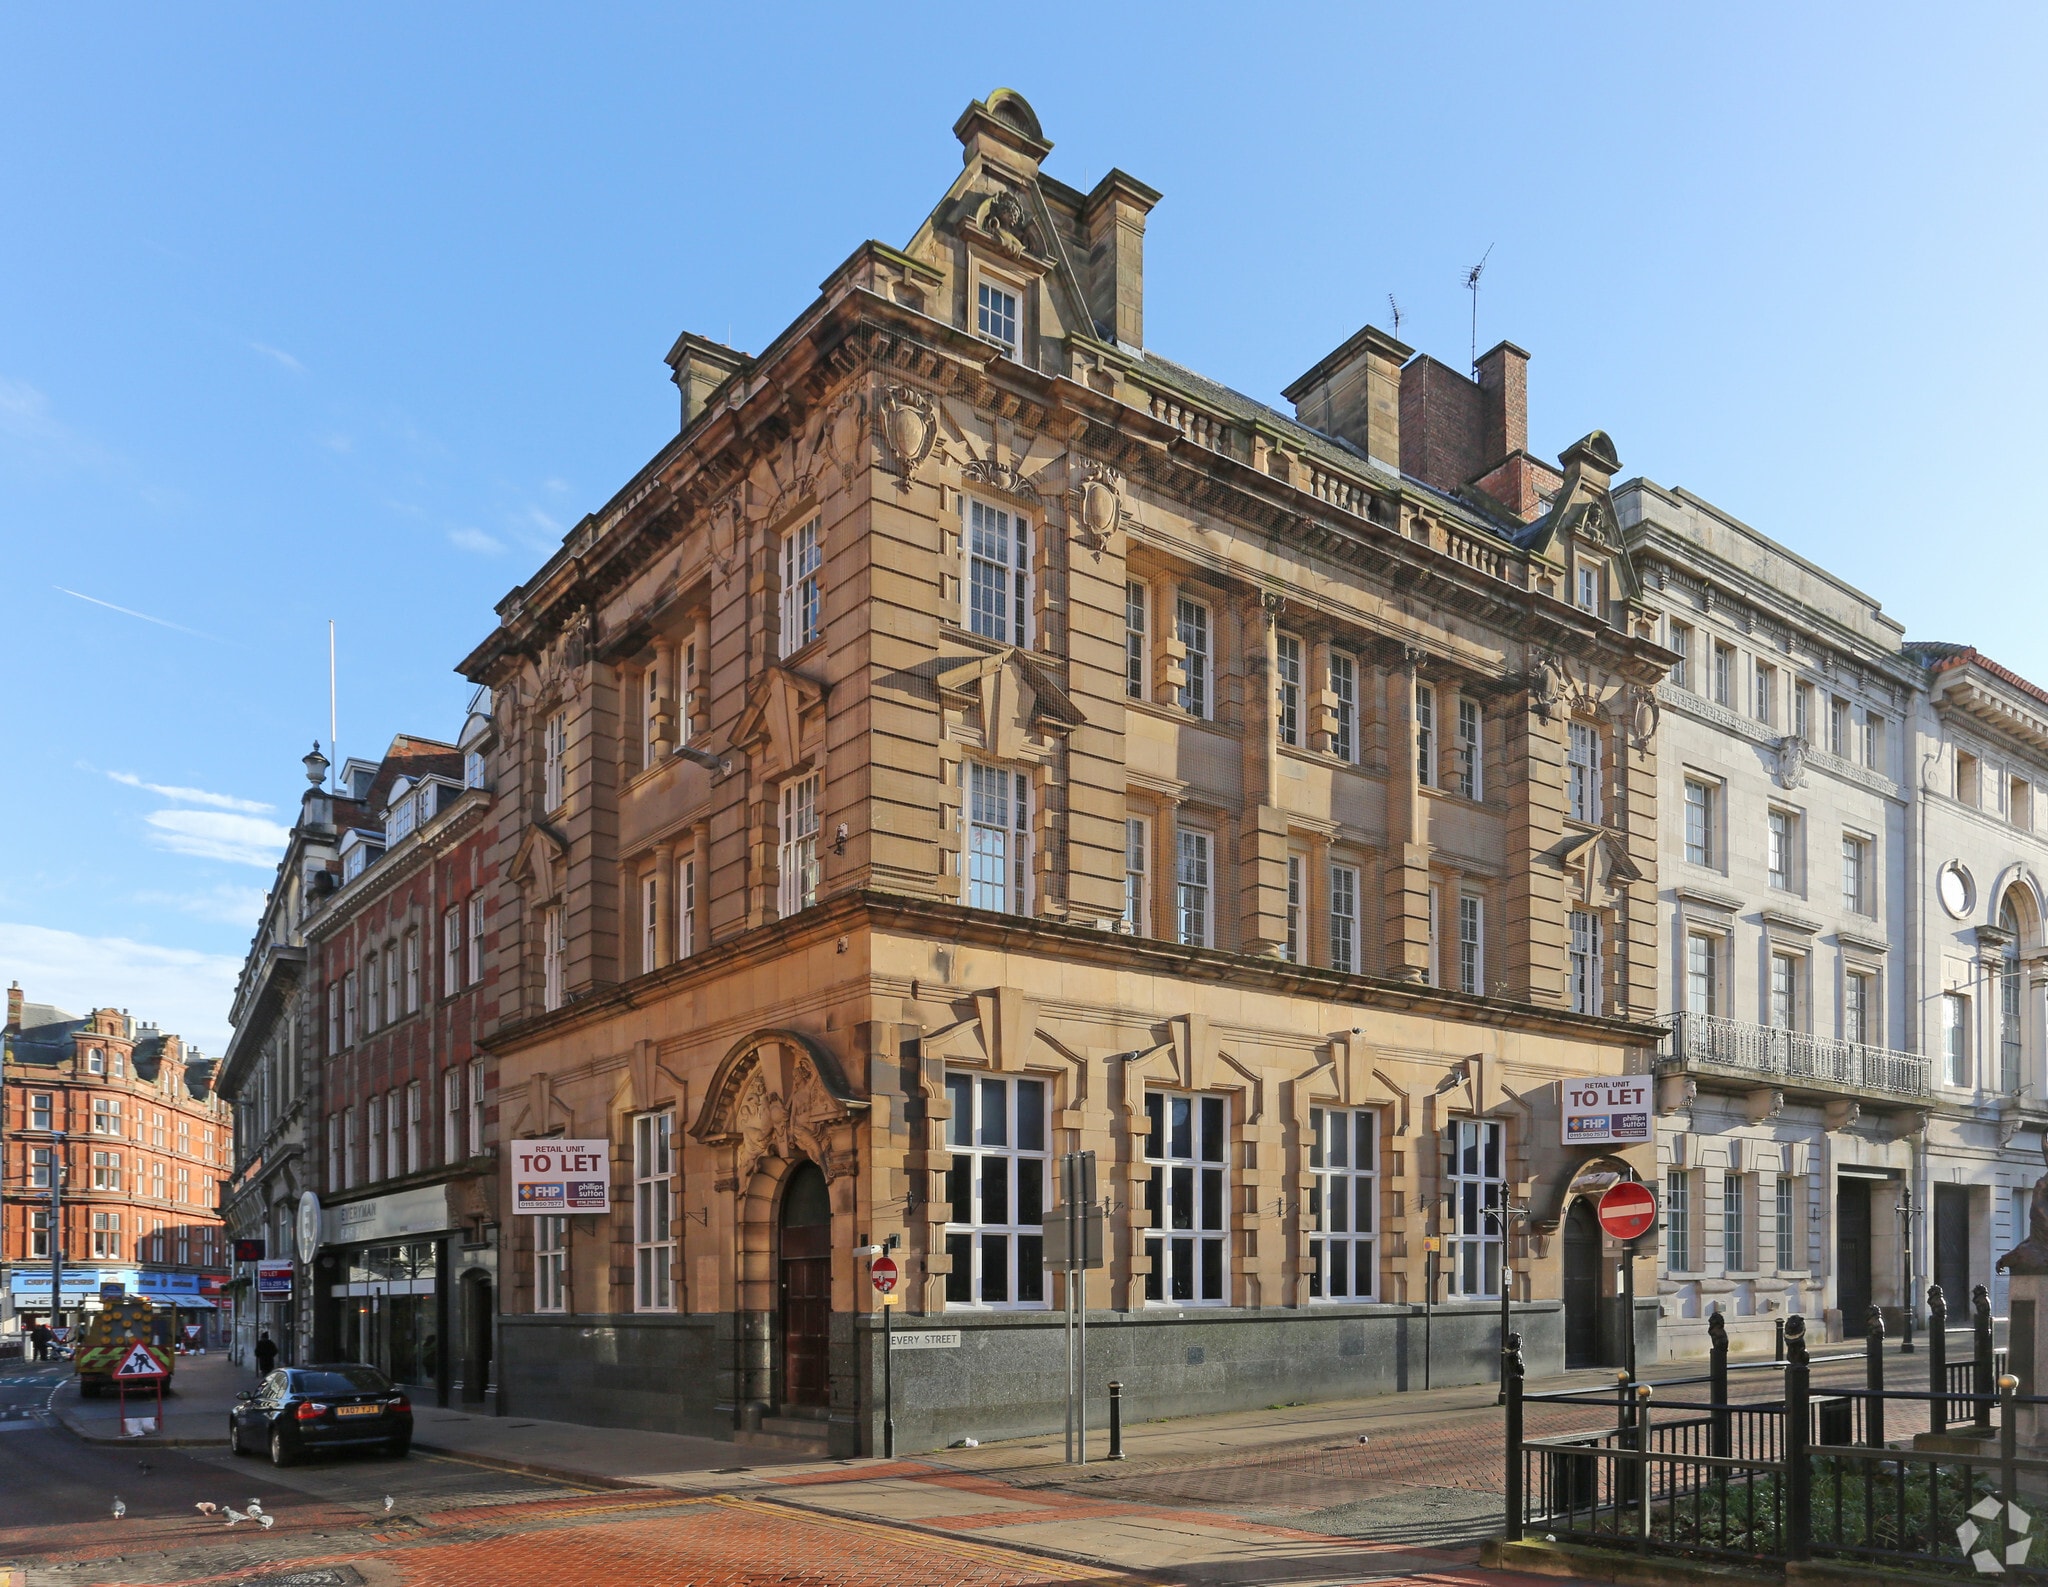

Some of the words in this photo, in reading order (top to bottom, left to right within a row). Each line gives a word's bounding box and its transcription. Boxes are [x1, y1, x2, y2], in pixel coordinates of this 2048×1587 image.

[1570, 1090, 1599, 1107] TO
[1607, 1088, 1645, 1106] LET
[1583, 1118, 1606, 1129] FHP
[1622, 1114, 1646, 1123] phillips
[520, 1154, 551, 1172] TO
[561, 1154, 601, 1172] LET
[535, 1186, 560, 1197] FHP
[578, 1183, 603, 1192] phillips
[341, 1202, 376, 1221] EVERYMAN
[891, 1336, 920, 1345] EVERY
[925, 1334, 957, 1344] STREET
